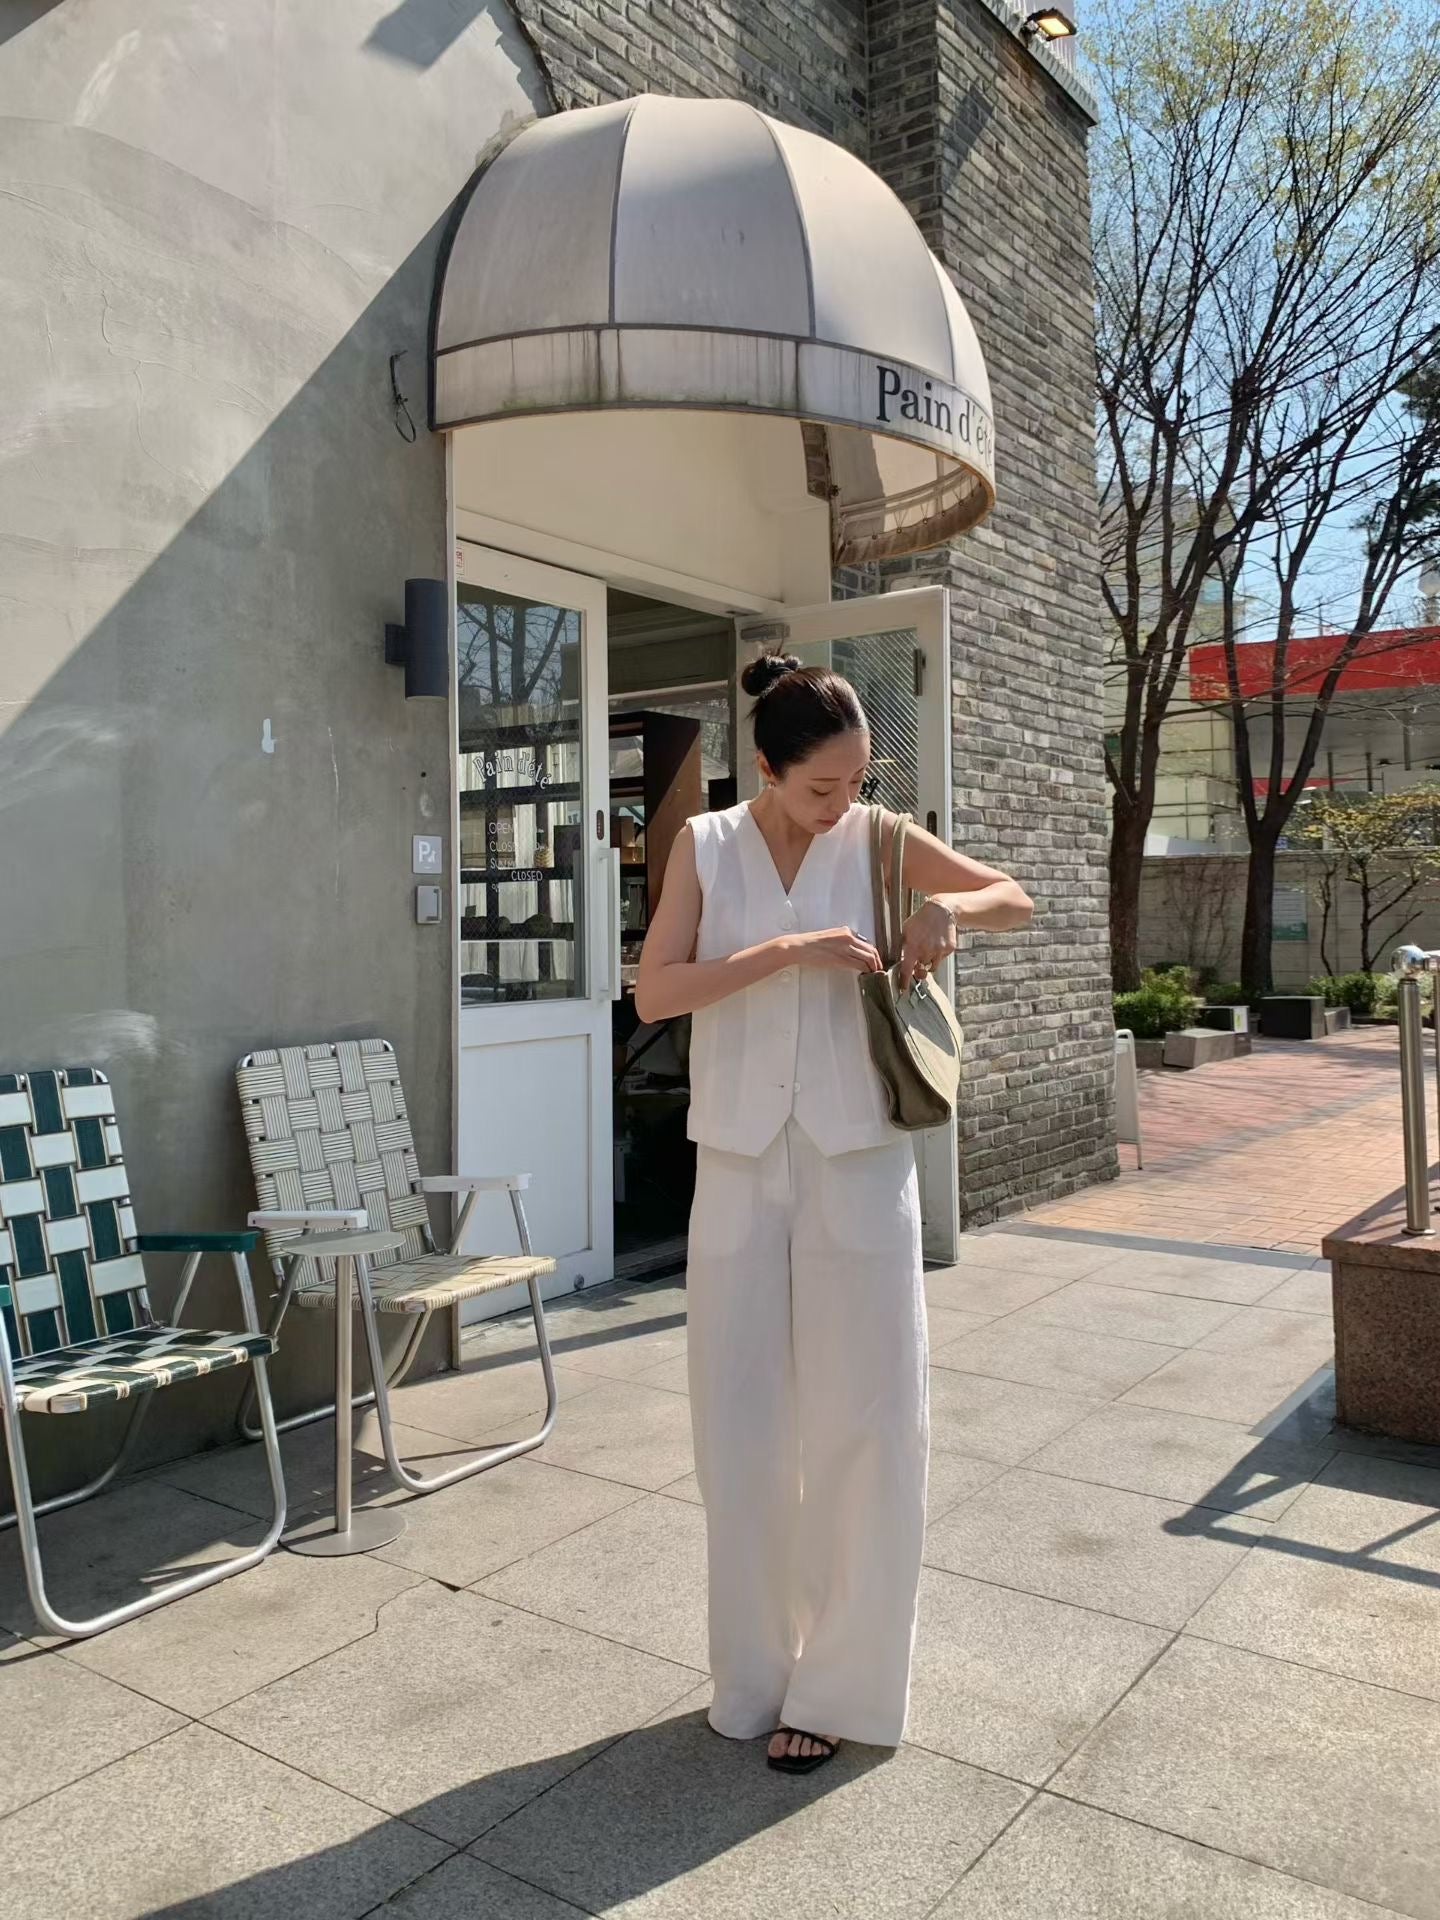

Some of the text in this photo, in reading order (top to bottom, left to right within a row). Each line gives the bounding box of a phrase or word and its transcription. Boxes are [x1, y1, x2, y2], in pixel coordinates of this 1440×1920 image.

[876, 365, 953, 435] Pain
[473, 752, 552, 789] Pain d'été
[511, 870, 543, 881] CLOSED
